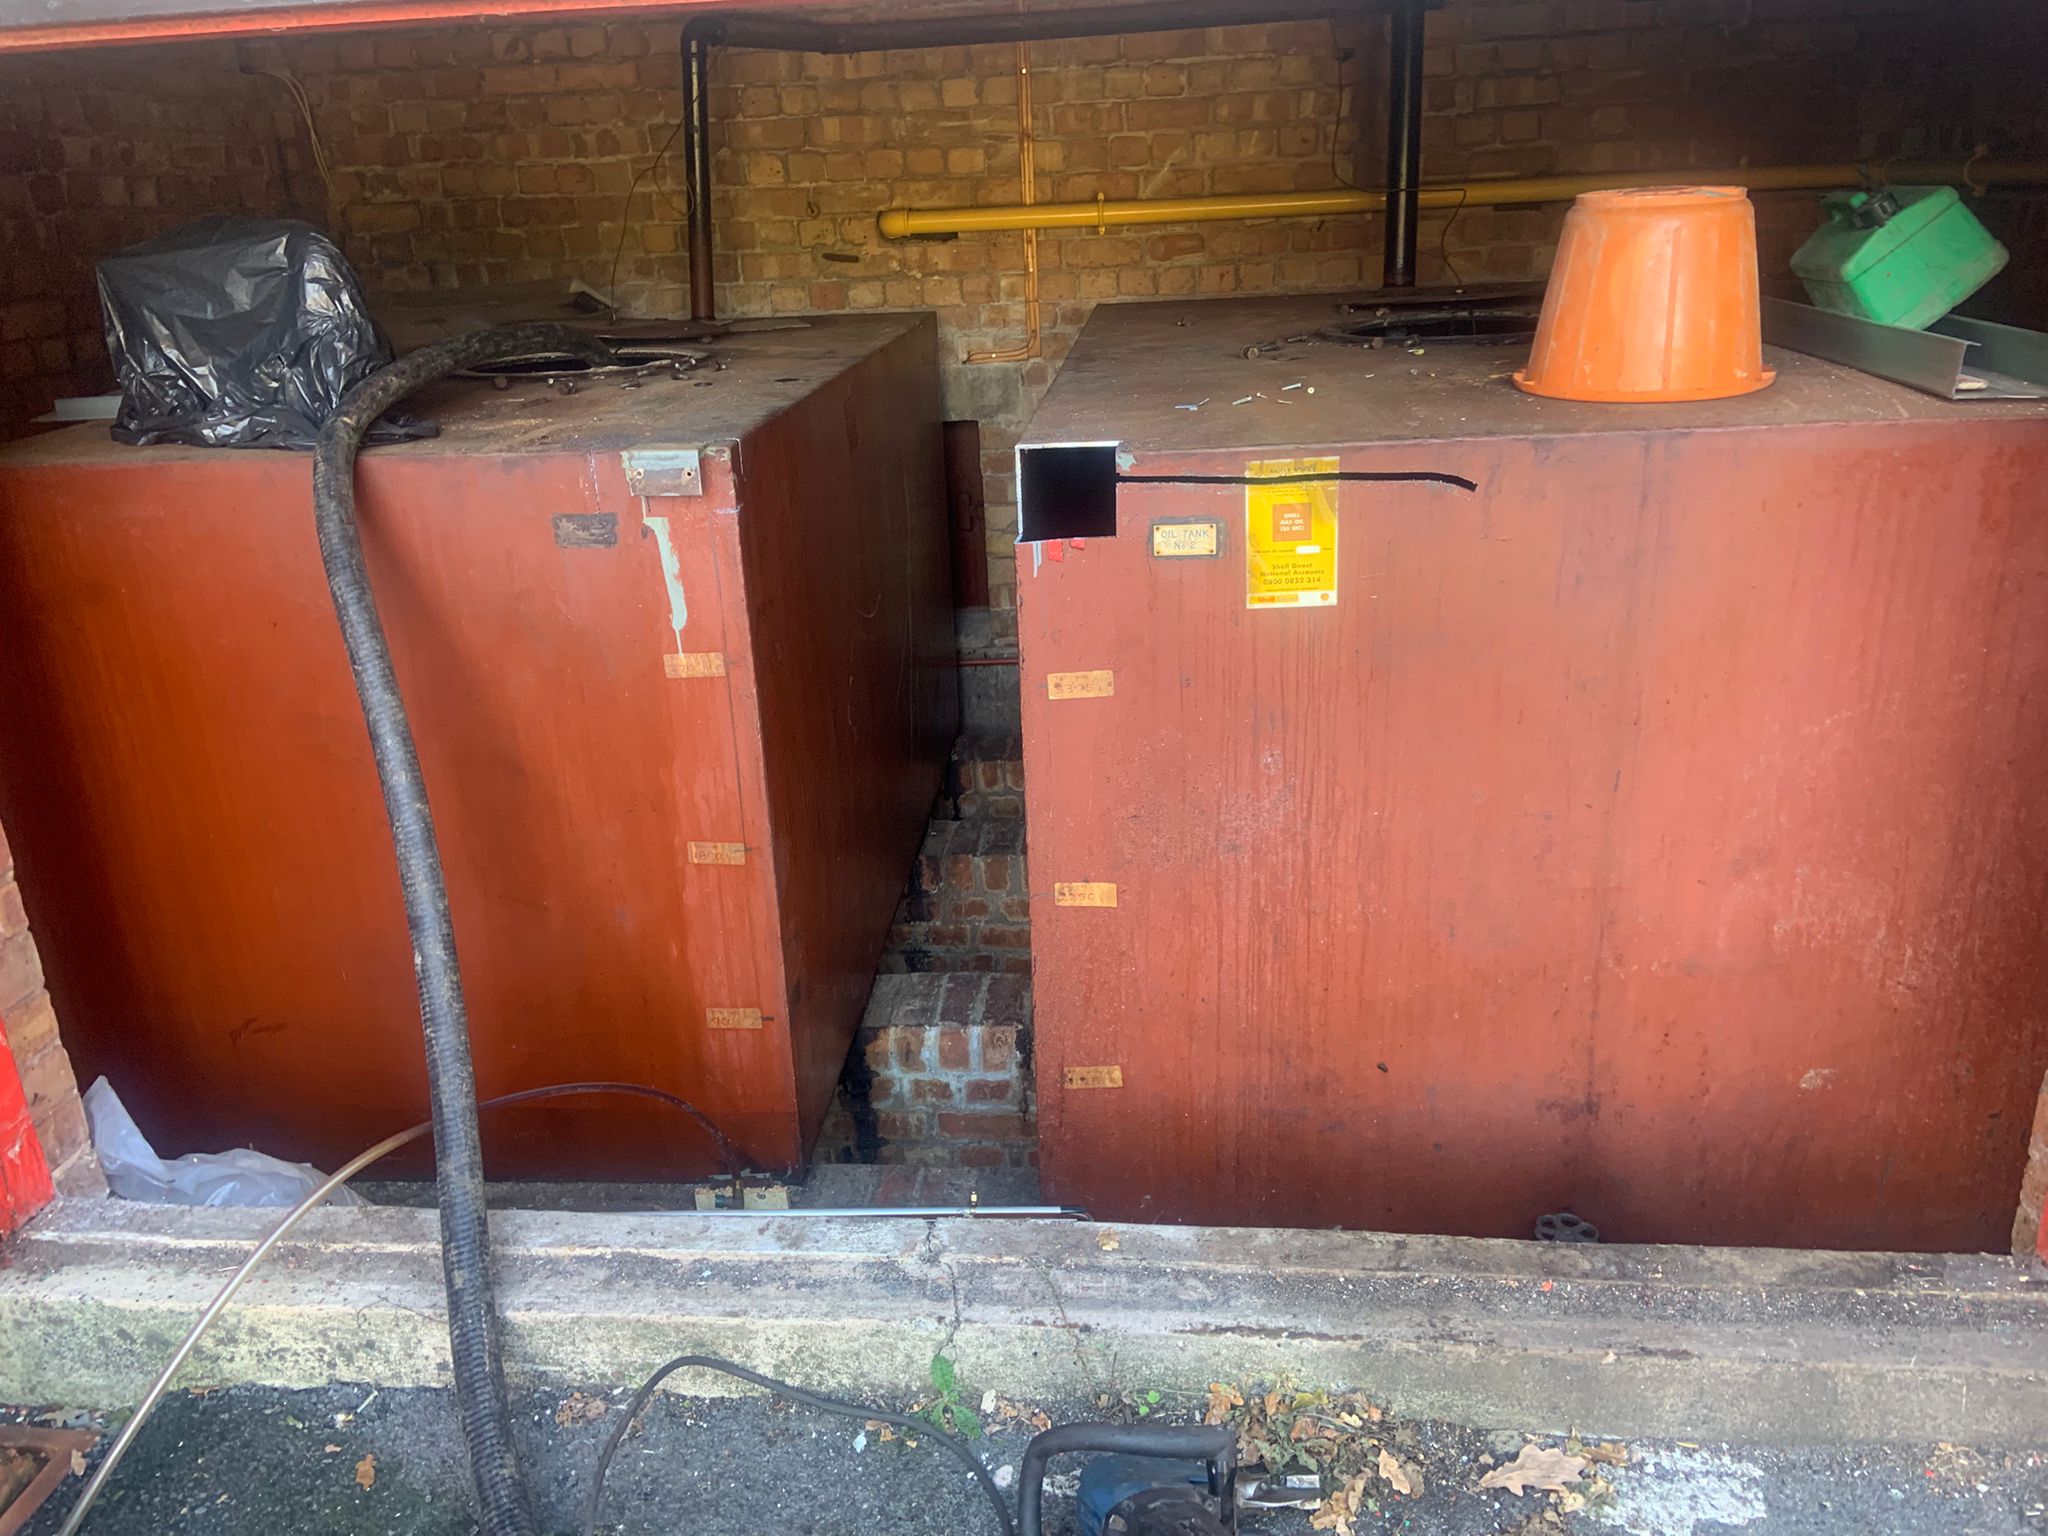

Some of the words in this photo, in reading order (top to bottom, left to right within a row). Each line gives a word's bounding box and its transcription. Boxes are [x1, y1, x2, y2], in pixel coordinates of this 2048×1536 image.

[1161, 530, 1177, 539] OIL
[1183, 529, 1209, 539] TANK
[1190, 541, 1197, 549] 2
[1260, 569, 1291, 577] National
[1263, 578, 1283, 586] 0800
